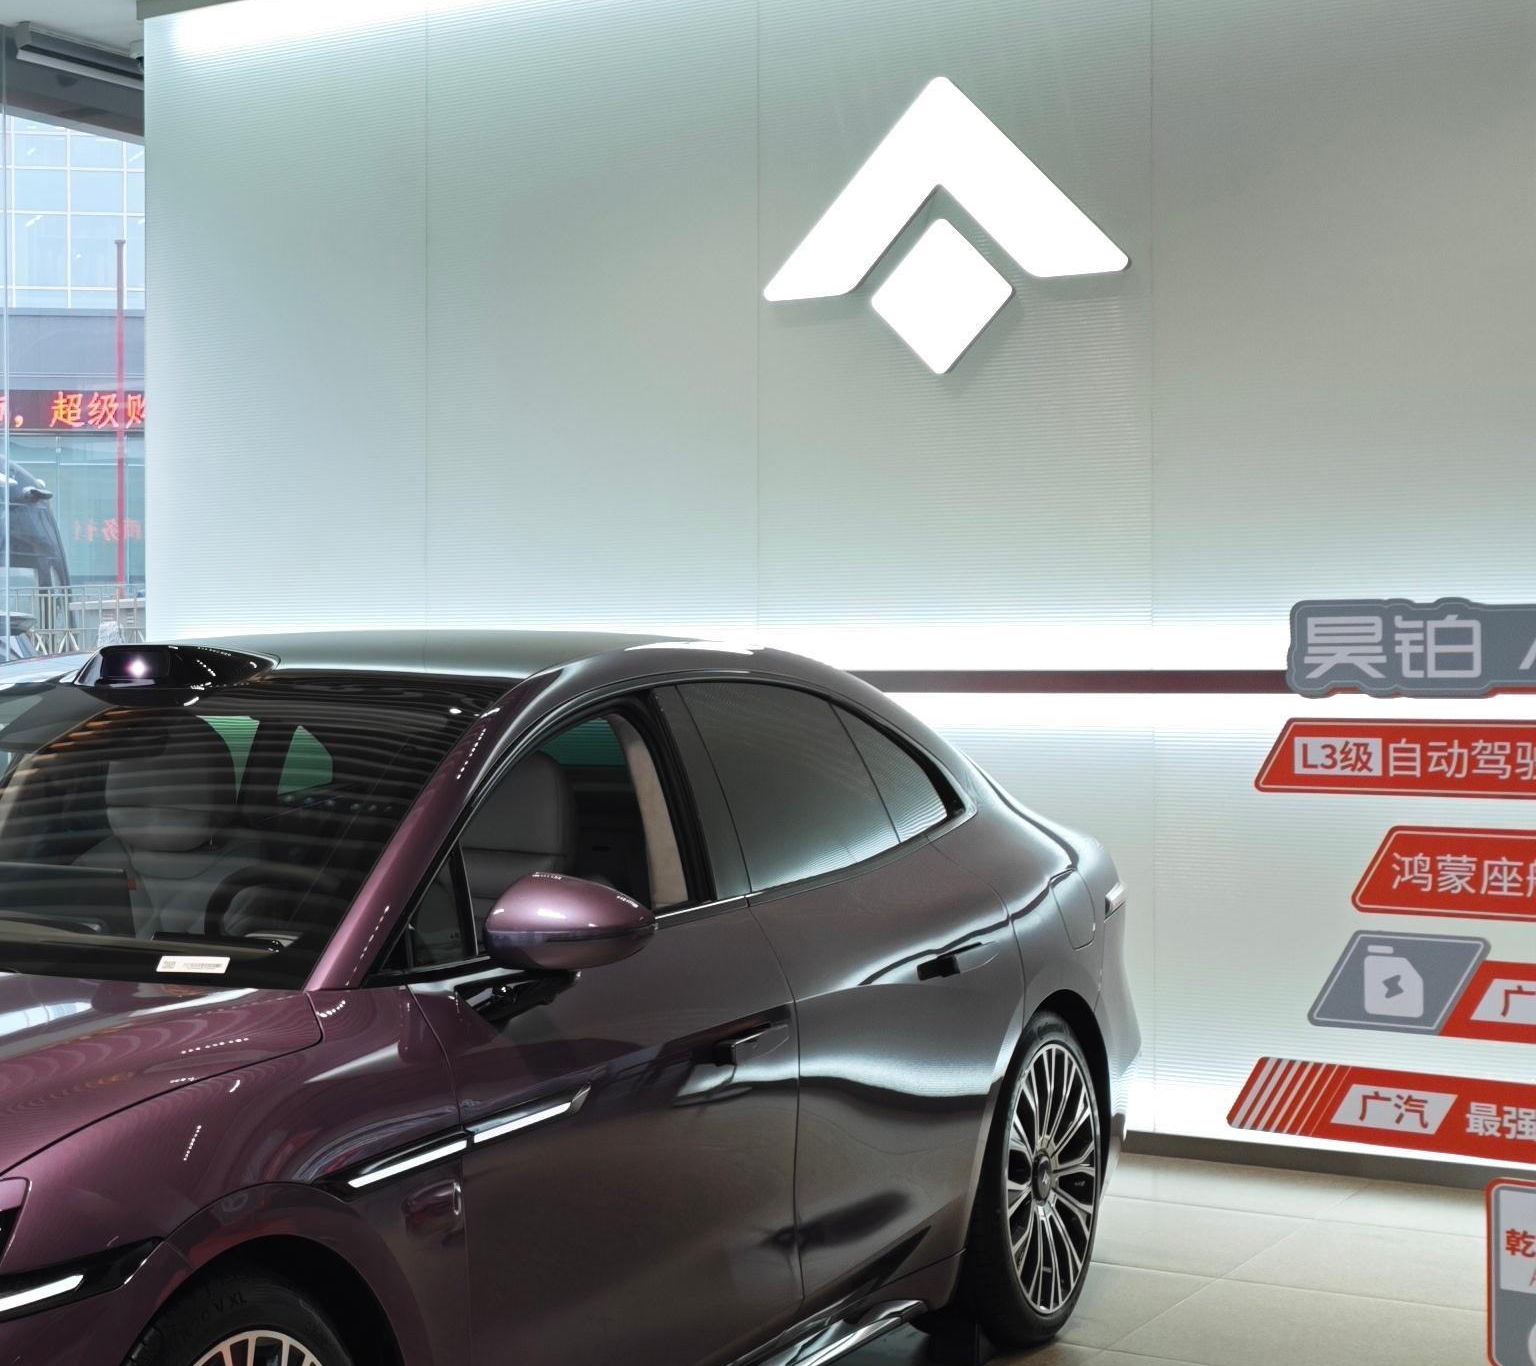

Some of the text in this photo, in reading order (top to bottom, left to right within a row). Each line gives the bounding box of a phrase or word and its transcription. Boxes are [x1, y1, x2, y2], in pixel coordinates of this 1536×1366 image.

[1304, 614, 1481, 679] 昊铂
[1392, 853, 1536, 898] 鸿蒙座
[1359, 1090, 1428, 1129] 广汽
